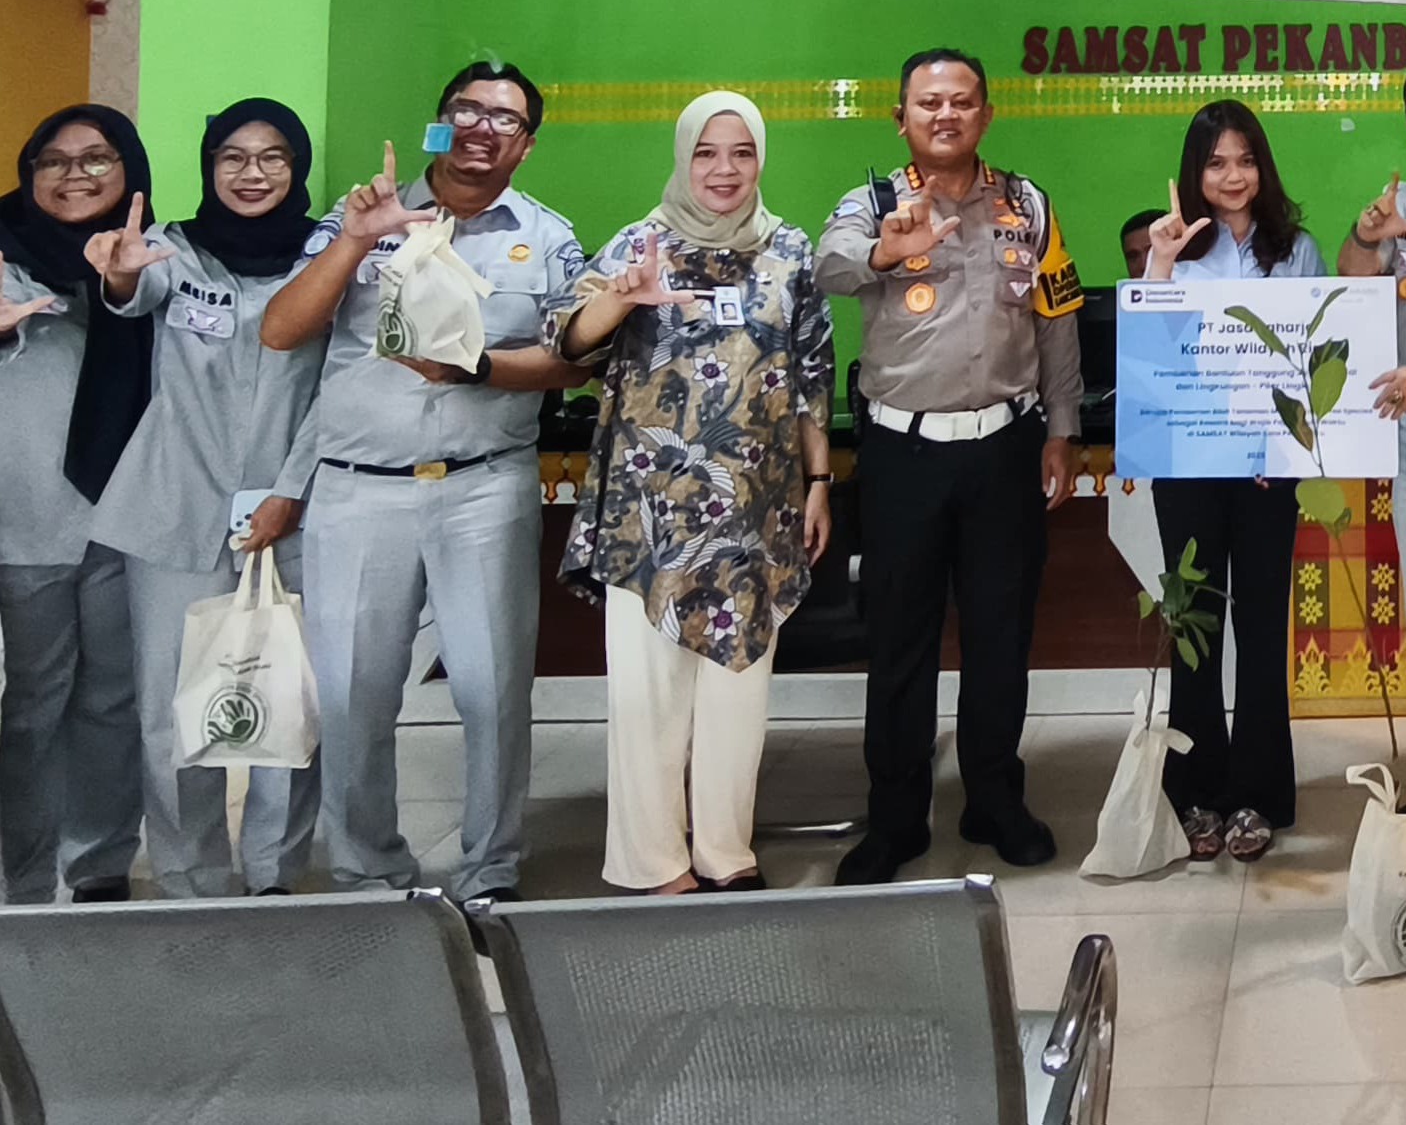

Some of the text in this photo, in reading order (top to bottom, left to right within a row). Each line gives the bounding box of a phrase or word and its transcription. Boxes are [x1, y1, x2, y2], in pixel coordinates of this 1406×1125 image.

[1021, 24, 1206, 74] SAMSAT
[1197, 322, 1214, 334] PT
[1218, 322, 1253, 334] Jasa
[1181, 342, 1230, 355] Kantor
[1235, 342, 1296, 357] Wilah
